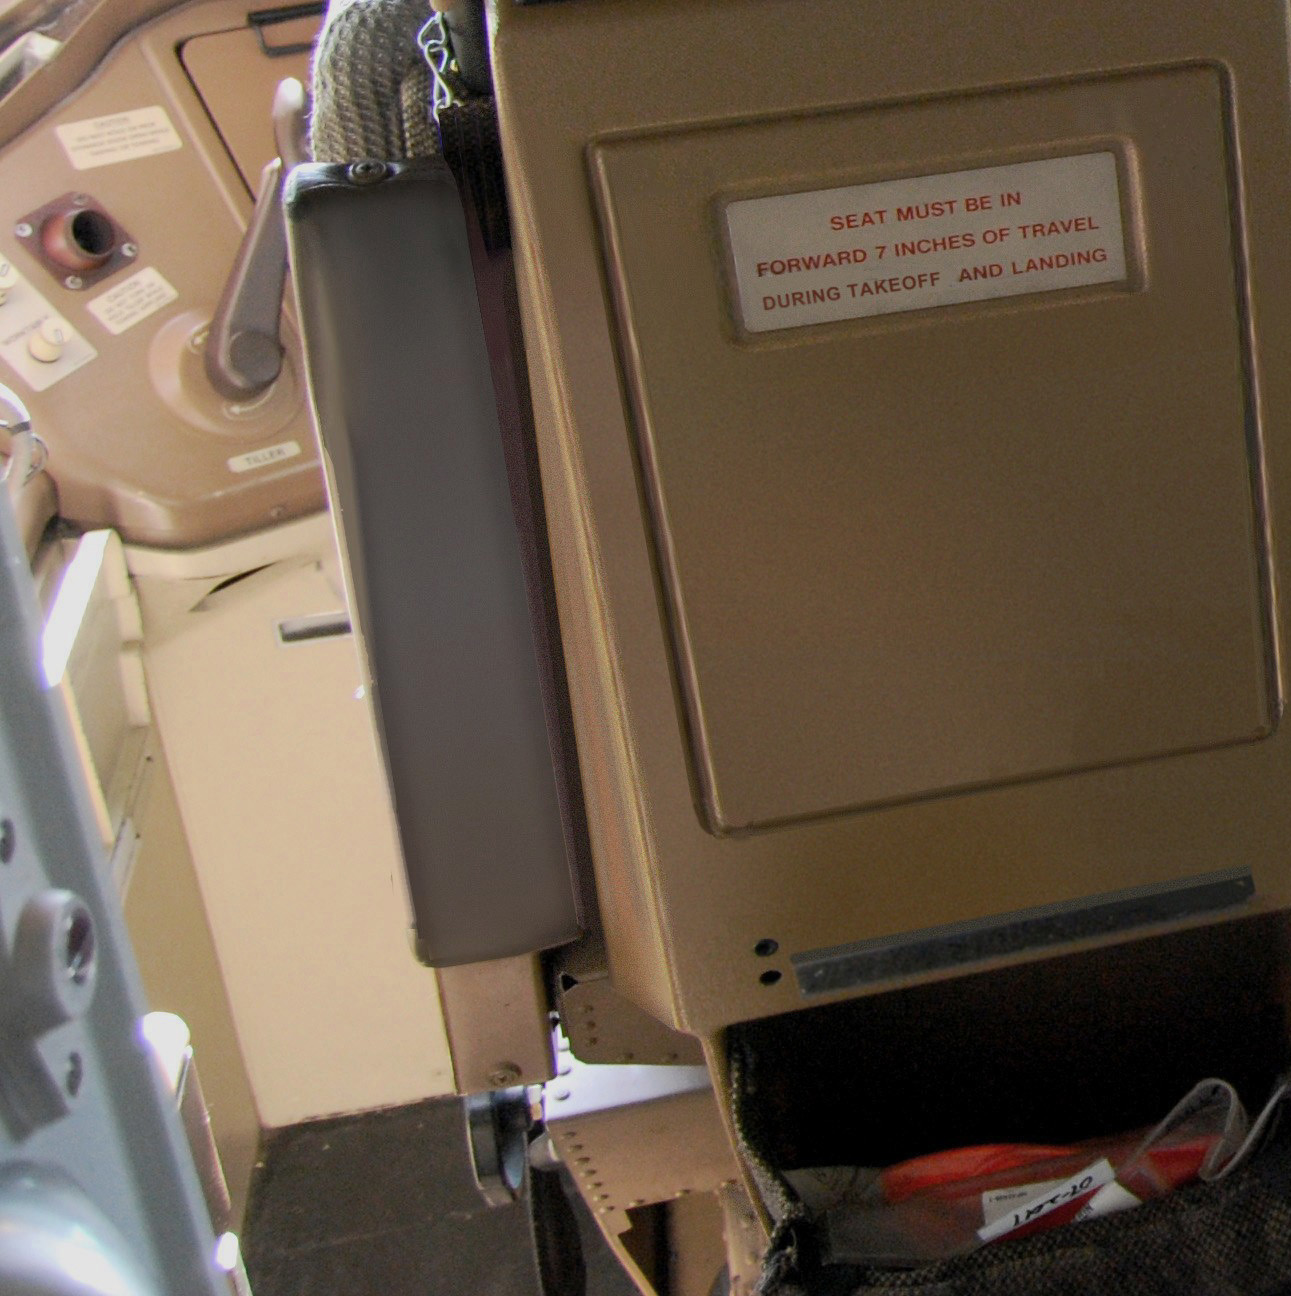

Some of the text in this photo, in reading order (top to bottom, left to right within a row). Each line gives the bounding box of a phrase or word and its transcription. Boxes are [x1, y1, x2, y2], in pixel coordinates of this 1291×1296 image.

[830, 191, 1022, 232] SEAT MUST BE IN
[757, 216, 1100, 277] FORWARD 7 INCHES OF TRAVEL
[763, 247, 1108, 311] DURING TAKEOFF AND LANDING
[245, 448, 287, 466] TILLER
